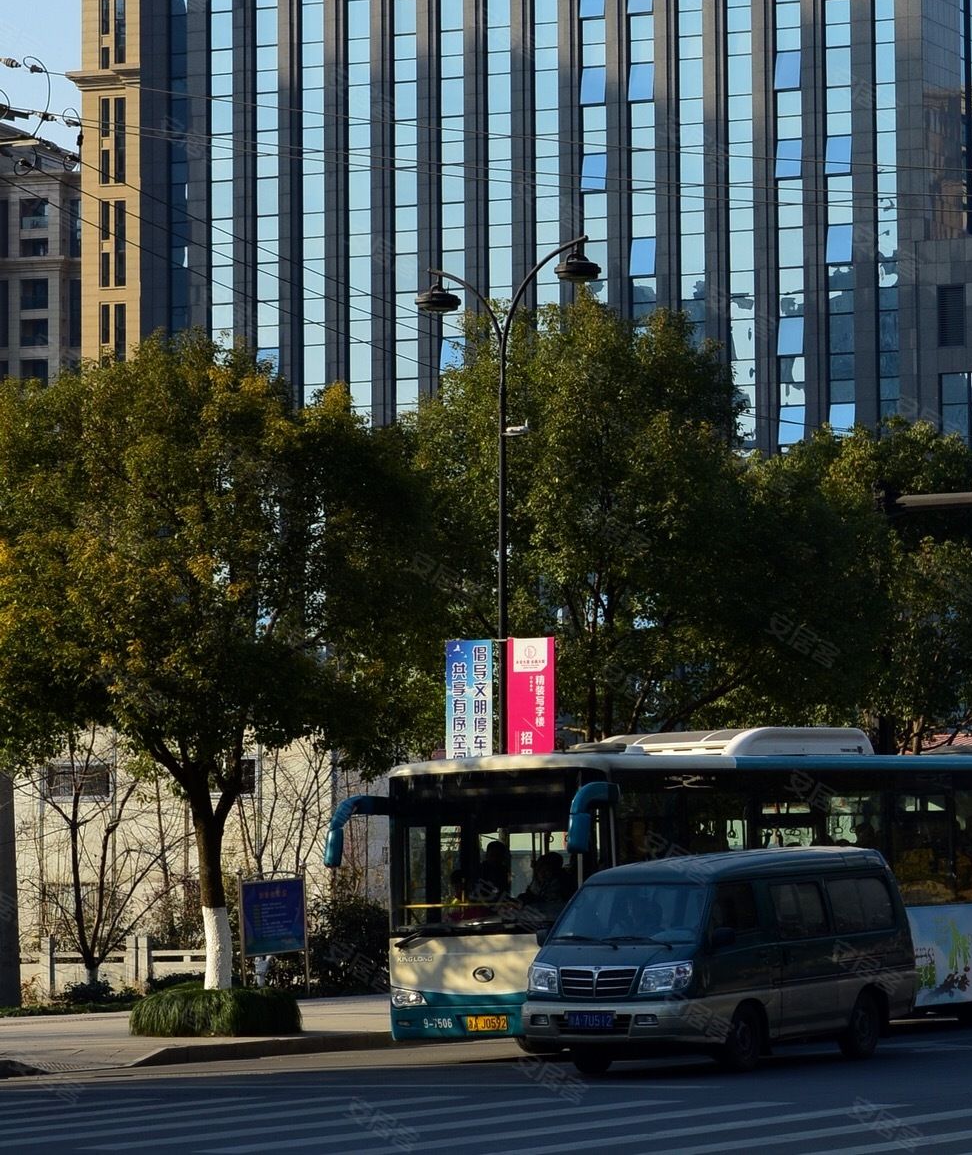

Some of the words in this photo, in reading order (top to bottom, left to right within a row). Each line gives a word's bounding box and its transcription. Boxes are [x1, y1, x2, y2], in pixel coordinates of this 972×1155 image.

[473, 645, 487, 749] 倡导文明停车
[535, 674, 545, 727] 精装写字楼
